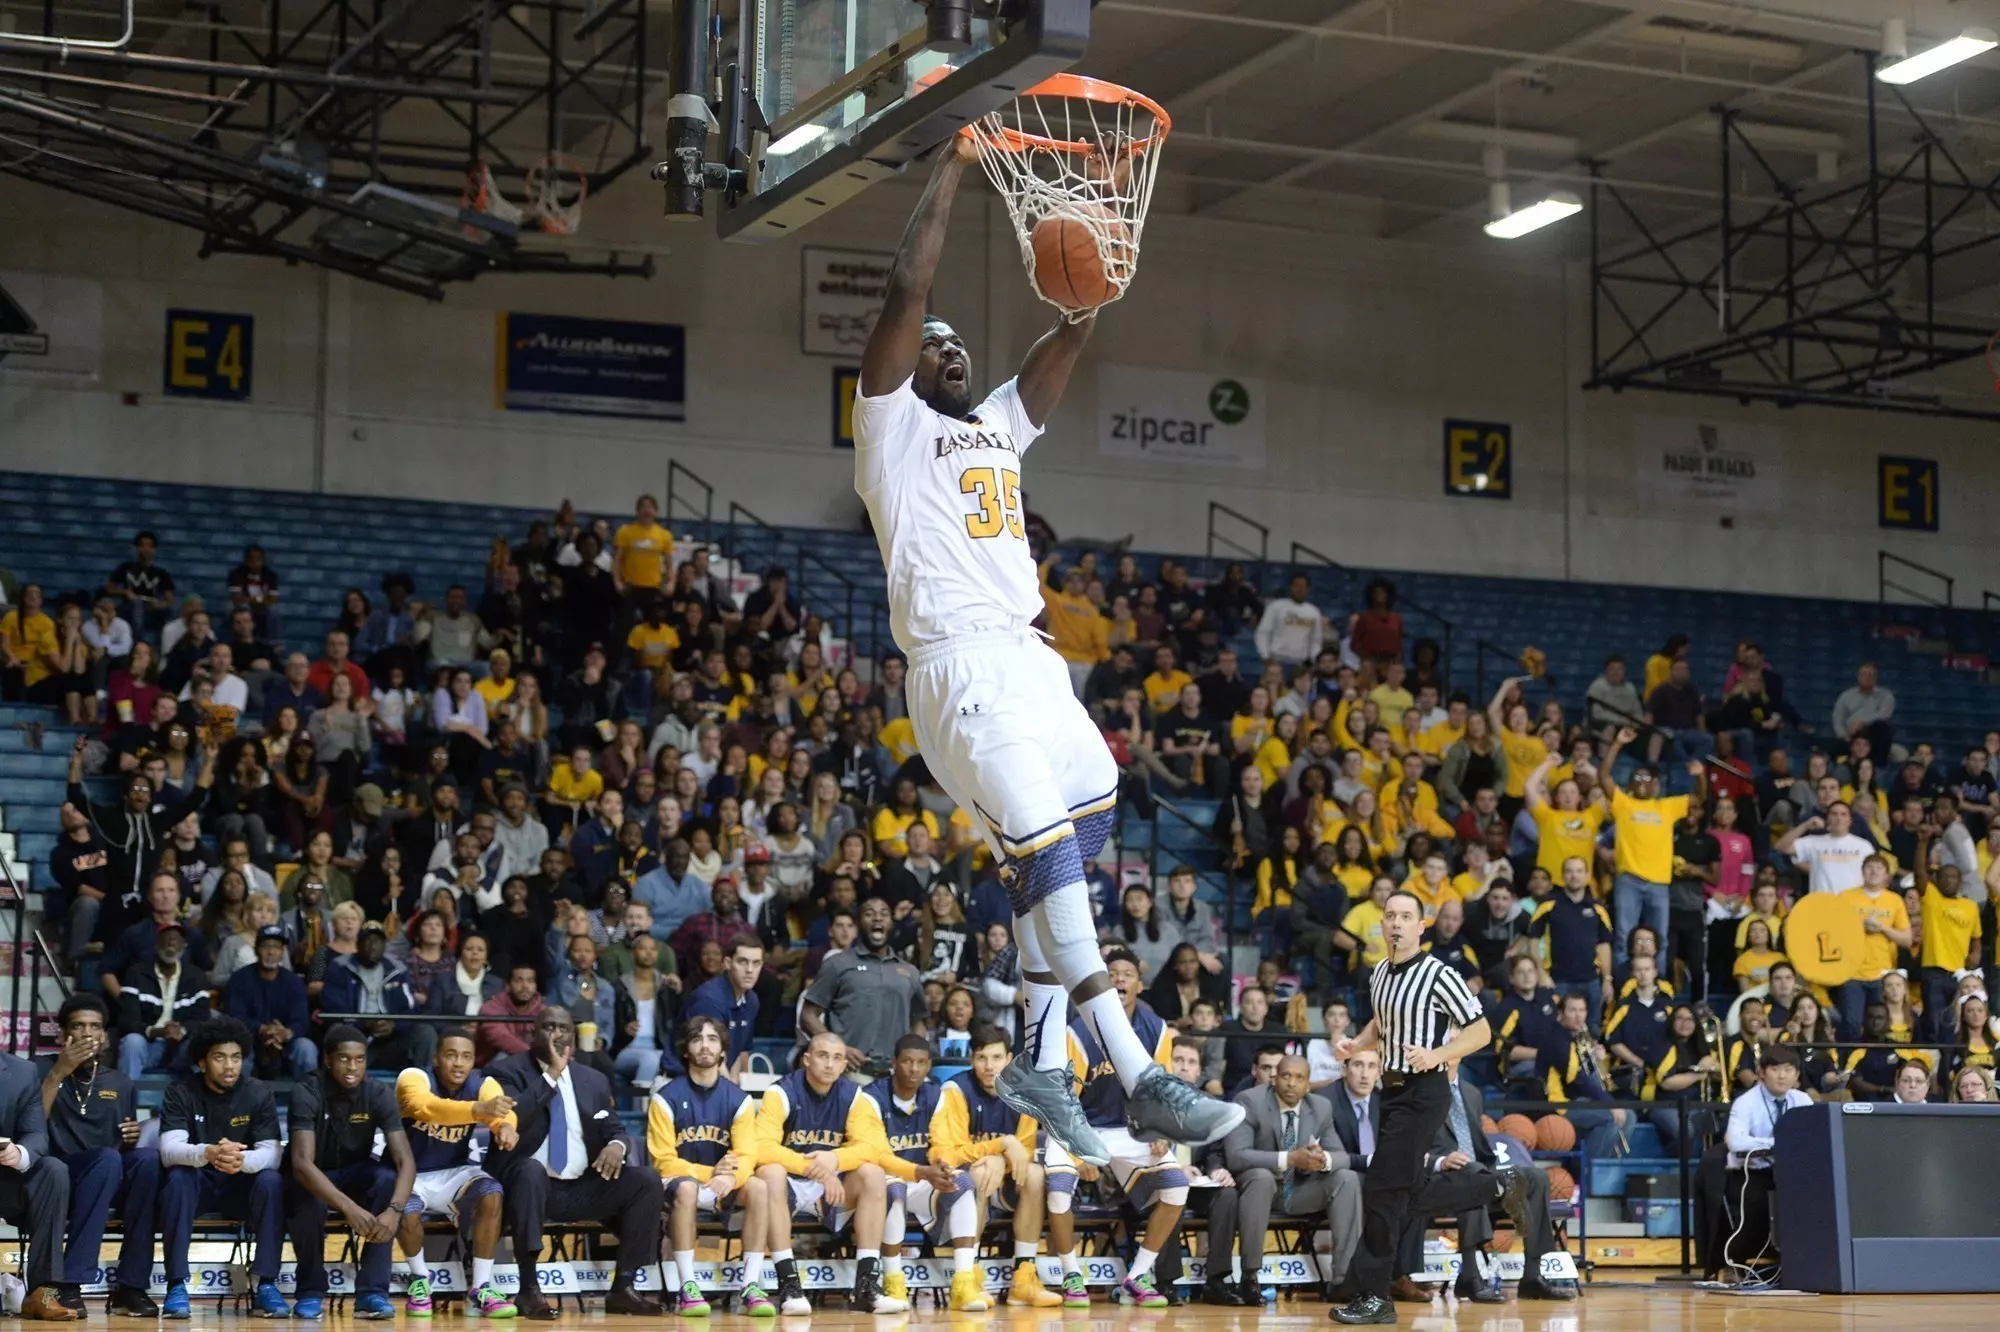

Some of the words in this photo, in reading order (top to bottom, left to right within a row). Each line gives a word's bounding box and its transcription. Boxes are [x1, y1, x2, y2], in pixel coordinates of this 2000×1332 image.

[1111, 406, 1214, 450] zipcar
[958, 466, 1025, 542] 35
[1817, 930, 1842, 962] L
[807, 1265, 836, 1282] 98
[901, 1264, 930, 1281] 98
[986, 1265, 1013, 1282] 98
[1088, 1263, 1117, 1279] 98
[1279, 1260, 1306, 1277] 98
[1540, 1257, 1564, 1273] 98
[200, 1269, 233, 1287] 98
[537, 1268, 565, 1287] 98
